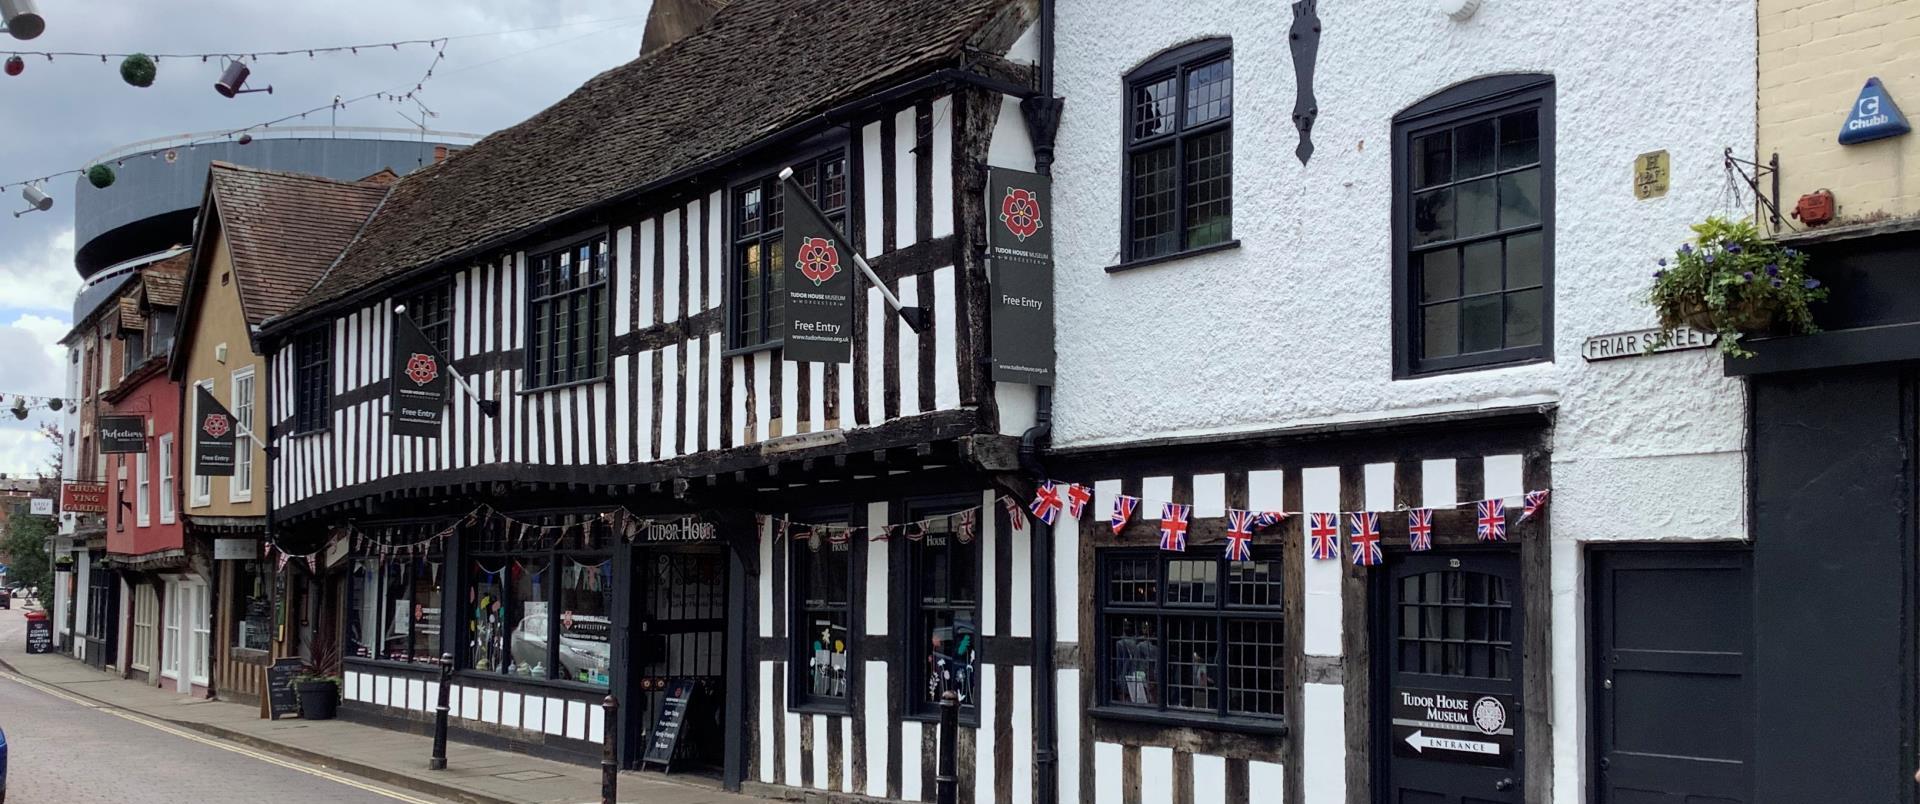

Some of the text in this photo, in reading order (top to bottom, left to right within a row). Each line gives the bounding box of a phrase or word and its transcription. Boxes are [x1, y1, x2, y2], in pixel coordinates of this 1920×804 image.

[1849, 114, 1889, 131] Chubb
[995, 246, 1049, 260] TUDOR HOUSE MUSEUM
[790, 291, 808, 299] TUDOR
[1002, 294, 1043, 311] Free Entry
[794, 320, 841, 335] Free Entry
[1590, 335, 1638, 357] FRIAR
[418, 410, 436, 418] Entry
[67, 484, 106, 493] CHUNG
[73, 494, 99, 502] YING
[1401, 692, 1469, 711] TUDOR HOUSE
[1427, 707, 1469, 723] MUSEUM
[1429, 738, 1486, 752] ENTRANCE
